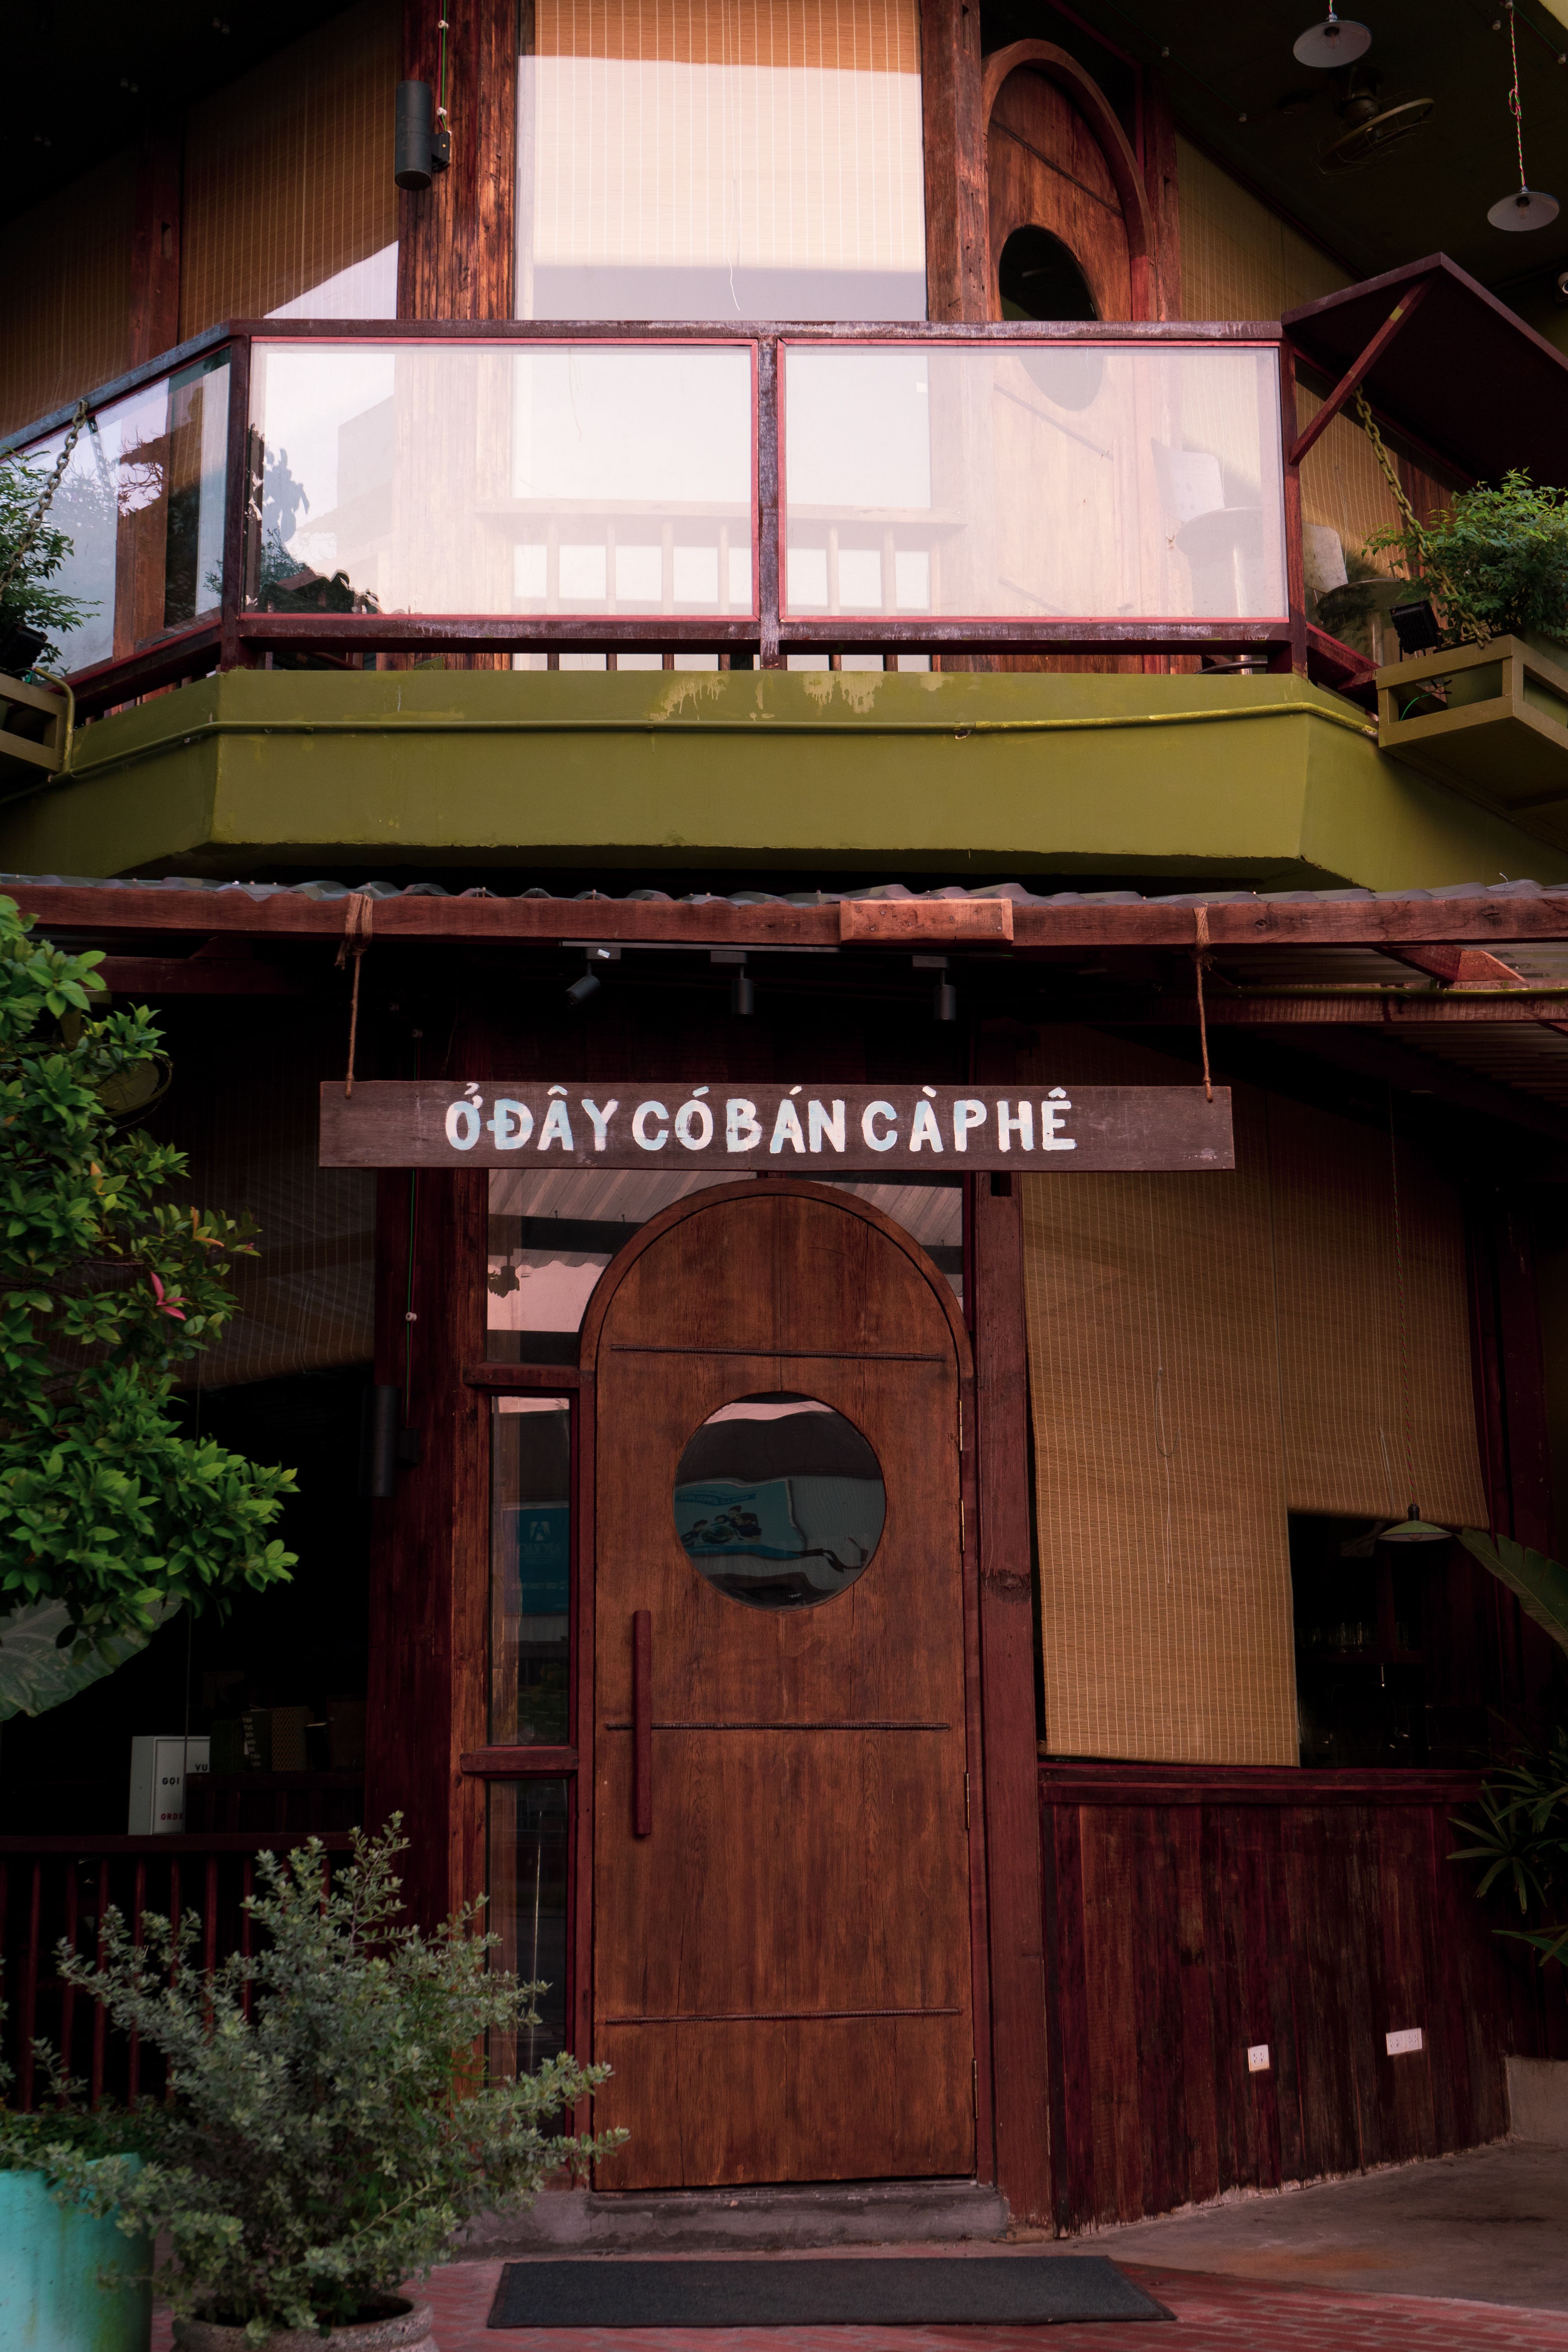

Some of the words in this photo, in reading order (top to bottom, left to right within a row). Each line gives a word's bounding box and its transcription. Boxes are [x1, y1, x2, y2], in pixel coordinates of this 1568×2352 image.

[632, 1086, 714, 1151] CÓ
[726, 1085, 846, 1154] BÁN
[860, 1085, 944, 1153] CÀ
[953, 1087, 1077, 1153] PHÊ
